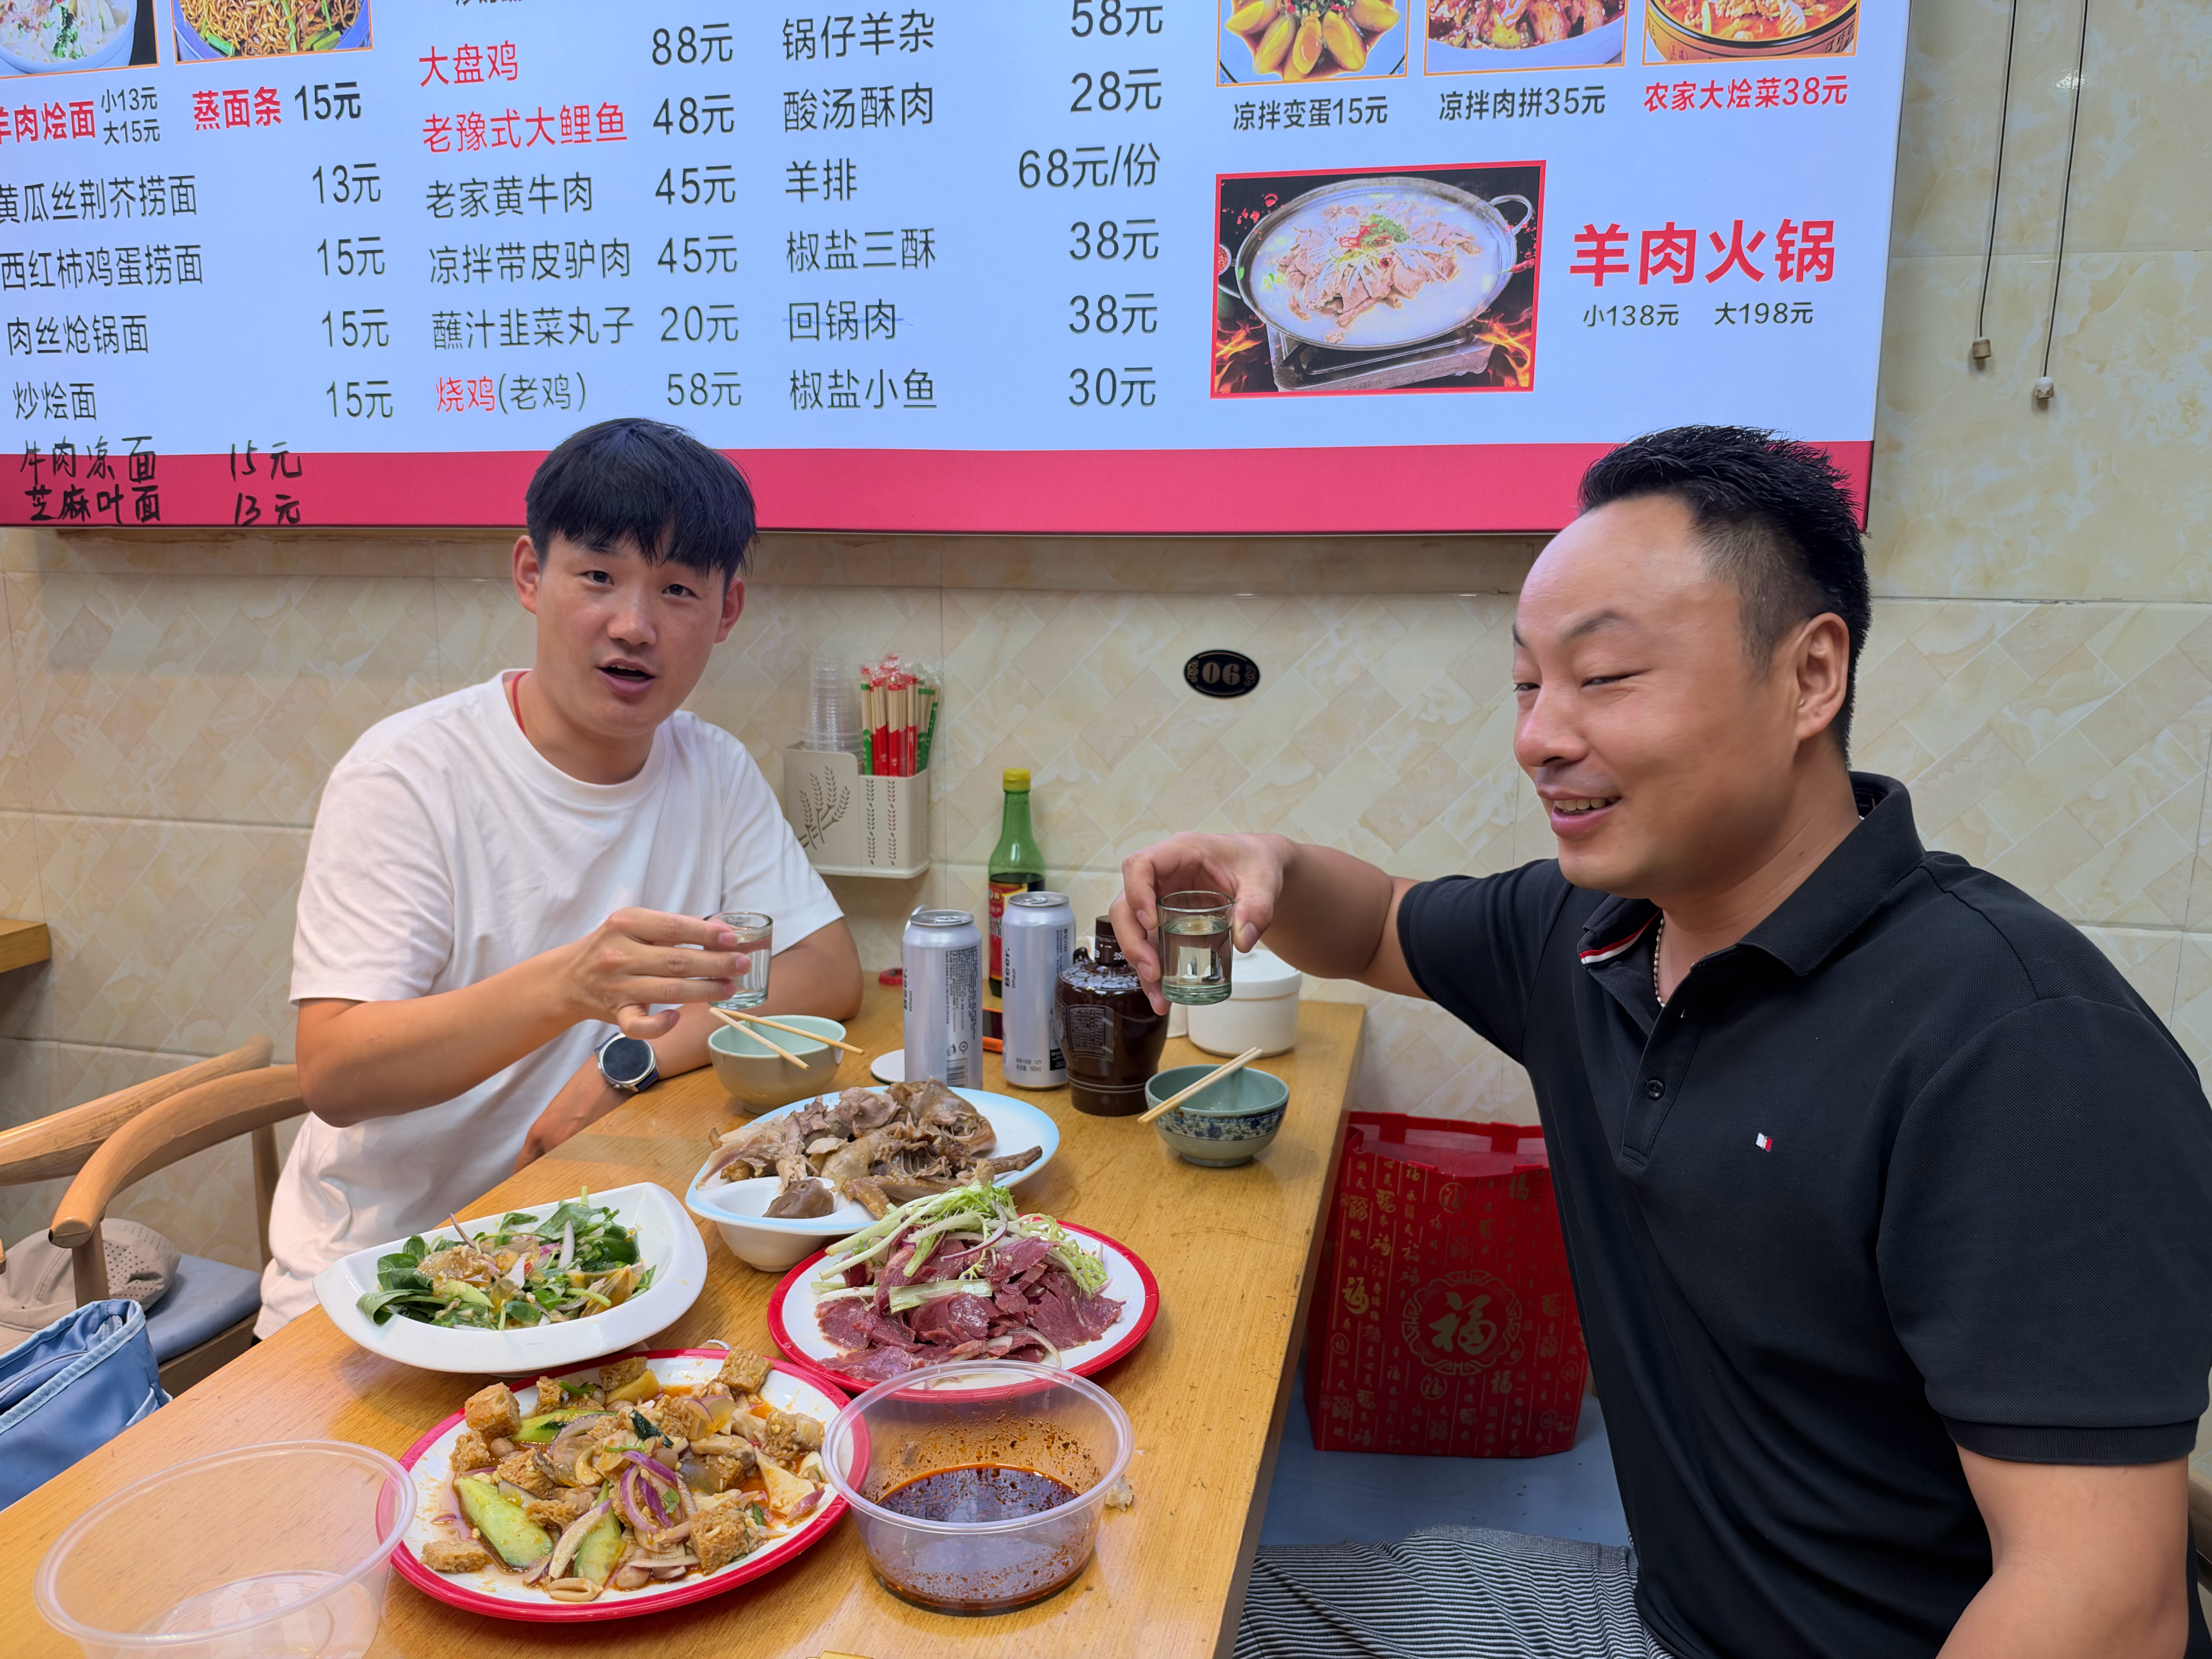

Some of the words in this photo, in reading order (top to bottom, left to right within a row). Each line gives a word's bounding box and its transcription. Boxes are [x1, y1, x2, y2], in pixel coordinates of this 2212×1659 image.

[419, 40, 518, 87] 大盘鸡
[652, 22, 733, 66] 88元
[782, 9, 935, 61] 锅仔羊杂
[1071, 0, 1163, 38] 58元
[101, 86, 158, 114] 小13元
[192, 86, 282, 131] 蒸面条
[294, 81, 362, 121] 15元
[783, 82, 933, 133] 酸汤酥肉
[1070, 68, 1162, 112] 28元
[1233, 96, 1388, 131] 凉拌变蛋15元
[1439, 85, 1606, 121] 凉拌肉拼35元
[1644, 75, 1848, 113] 农家大烩菜38元
[103, 118, 160, 146] 大15元
[422, 101, 627, 153] 老豫式大鲤鱼
[653, 94, 735, 136] 48元
[0, 175, 197, 225] 黄瓜丝荆芥捞面
[312, 163, 381, 204] 13元
[426, 172, 592, 218] 老家黄牛肉
[655, 165, 736, 206] 45元
[785, 157, 857, 203] 羊排
[1018, 143, 1160, 189] 68元/份
[0, 244, 203, 292] 西红柿鸡蛋捞面
[317, 236, 385, 277] 15元
[429, 238, 630, 285] 凉拌带皮驴肉
[657, 235, 737, 275] 45元
[786, 228, 936, 273] 椒盐三酥
[1069, 218, 1159, 261] 38元
[1569, 218, 1835, 287] 羊肉火锅
[7, 314, 149, 356] 肉丝炝锅面
[321, 308, 389, 349] 15元
[432, 306, 634, 350] 蘸汁韭菜丸子
[660, 304, 739, 343] 20元
[789, 298, 895, 342] 回锅肉
[1068, 293, 1158, 335] 38元
[1583, 304, 1679, 327] 小138元
[1714, 301, 1814, 326] 大198元
[12, 381, 97, 421] 炒烩面
[326, 380, 393, 419] 15元
[435, 372, 586, 414] 烧鸡(老鸡)
[667, 372, 742, 407] 58元
[789, 368, 937, 410] 椒盐小鱼
[1068, 367, 1156, 407] 30元
[20, 435, 156, 485] 牛肉凉面
[230, 439, 302, 482] 15元
[25, 484, 160, 522] 芝麻叶面
[234, 494, 301, 526] 13元
[1202, 662, 1240, 685] 06
[1429, 1291, 1496, 1355] 福
